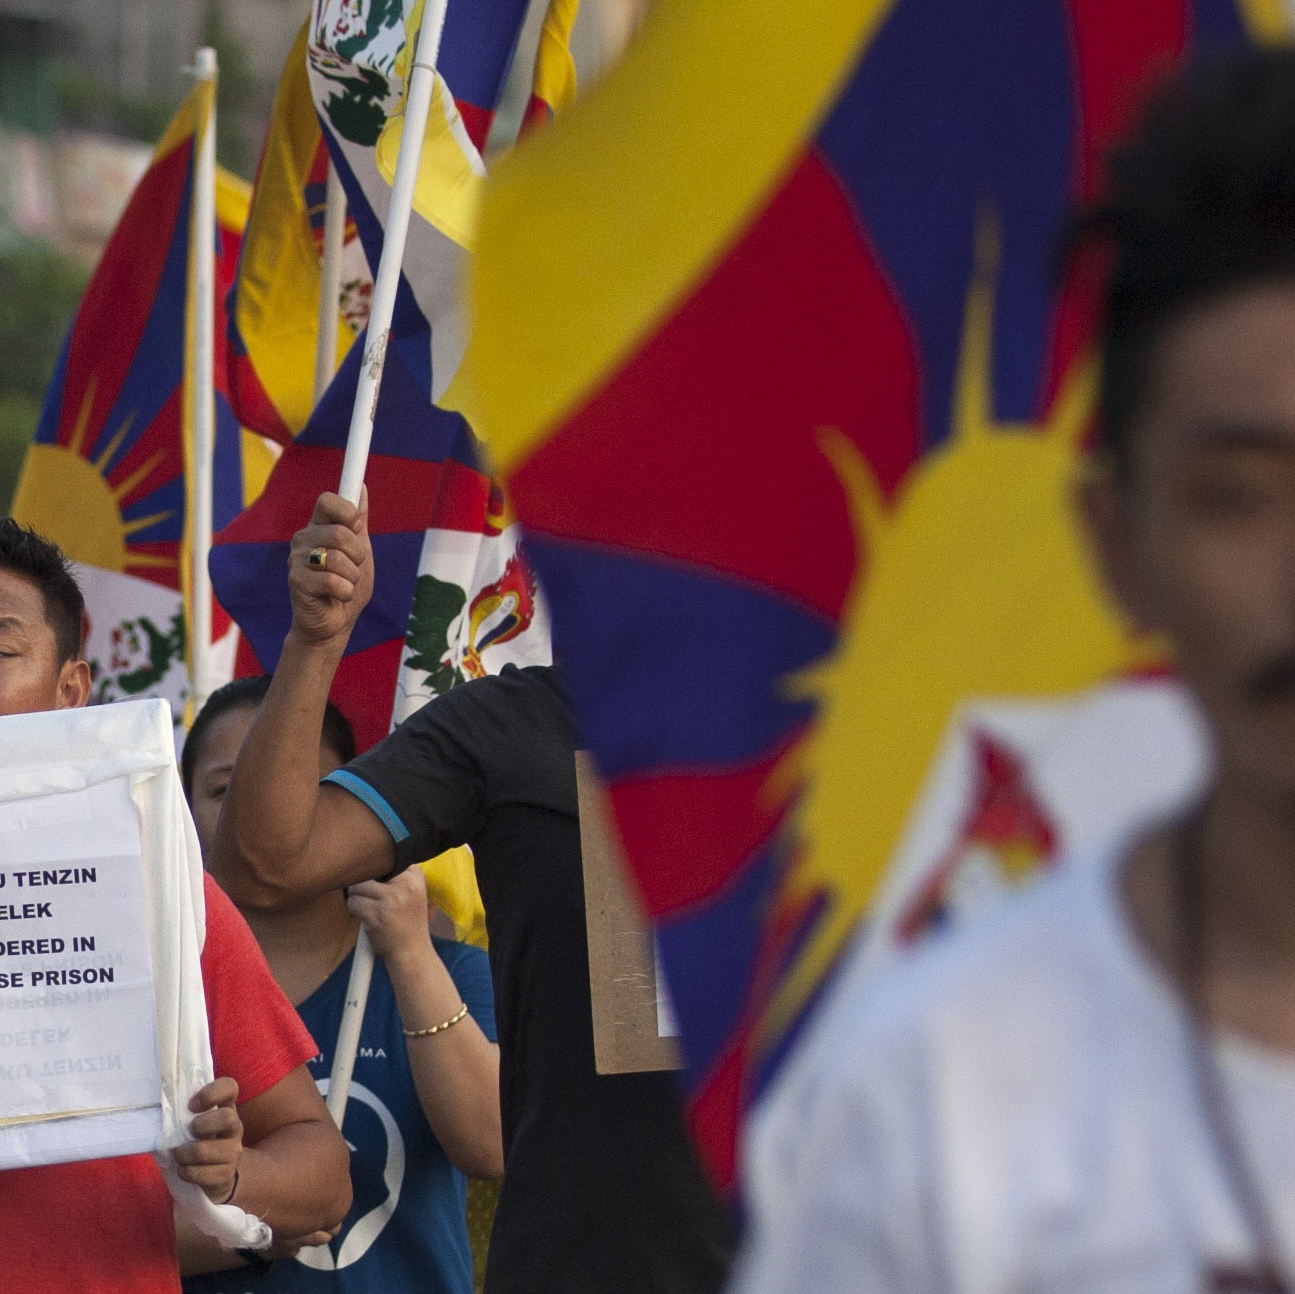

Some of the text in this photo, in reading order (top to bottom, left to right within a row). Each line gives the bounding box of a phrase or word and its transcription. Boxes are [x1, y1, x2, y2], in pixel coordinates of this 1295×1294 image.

[12, 867, 97, 888] TENZIN
[72, 936, 96, 953] IN
[31, 967, 114, 987] PRISON
